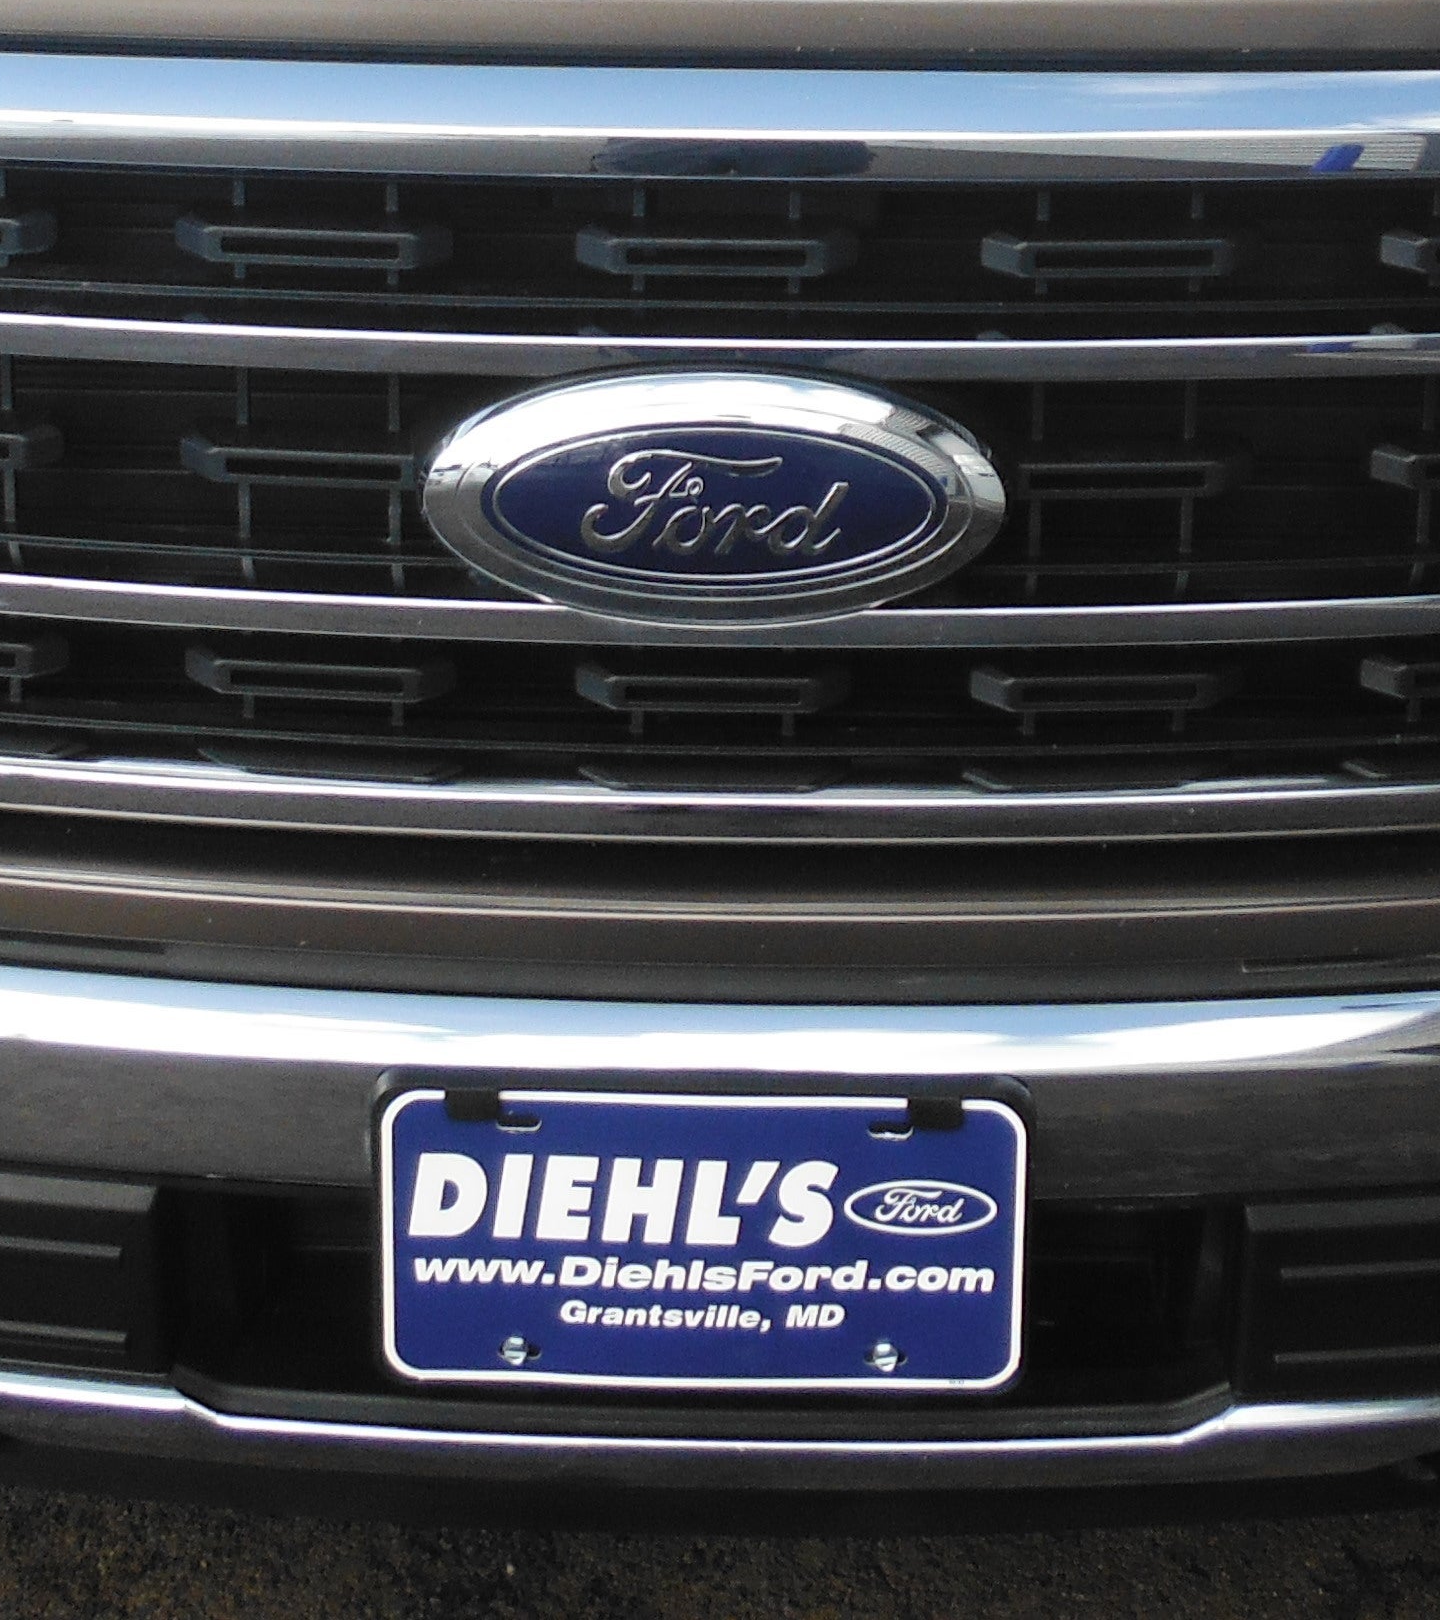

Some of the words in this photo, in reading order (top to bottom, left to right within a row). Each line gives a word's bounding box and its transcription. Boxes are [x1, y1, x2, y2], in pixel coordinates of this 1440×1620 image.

[580, 448, 849, 557] Ford
[408, 1152, 840, 1247] DIEHL'S
[873, 1187, 964, 1225] Ford
[413, 1254, 996, 1294] www.DiehlsFord.com
[560, 1298, 773, 1332] Grantsville,
[785, 1303, 846, 1329] MD
